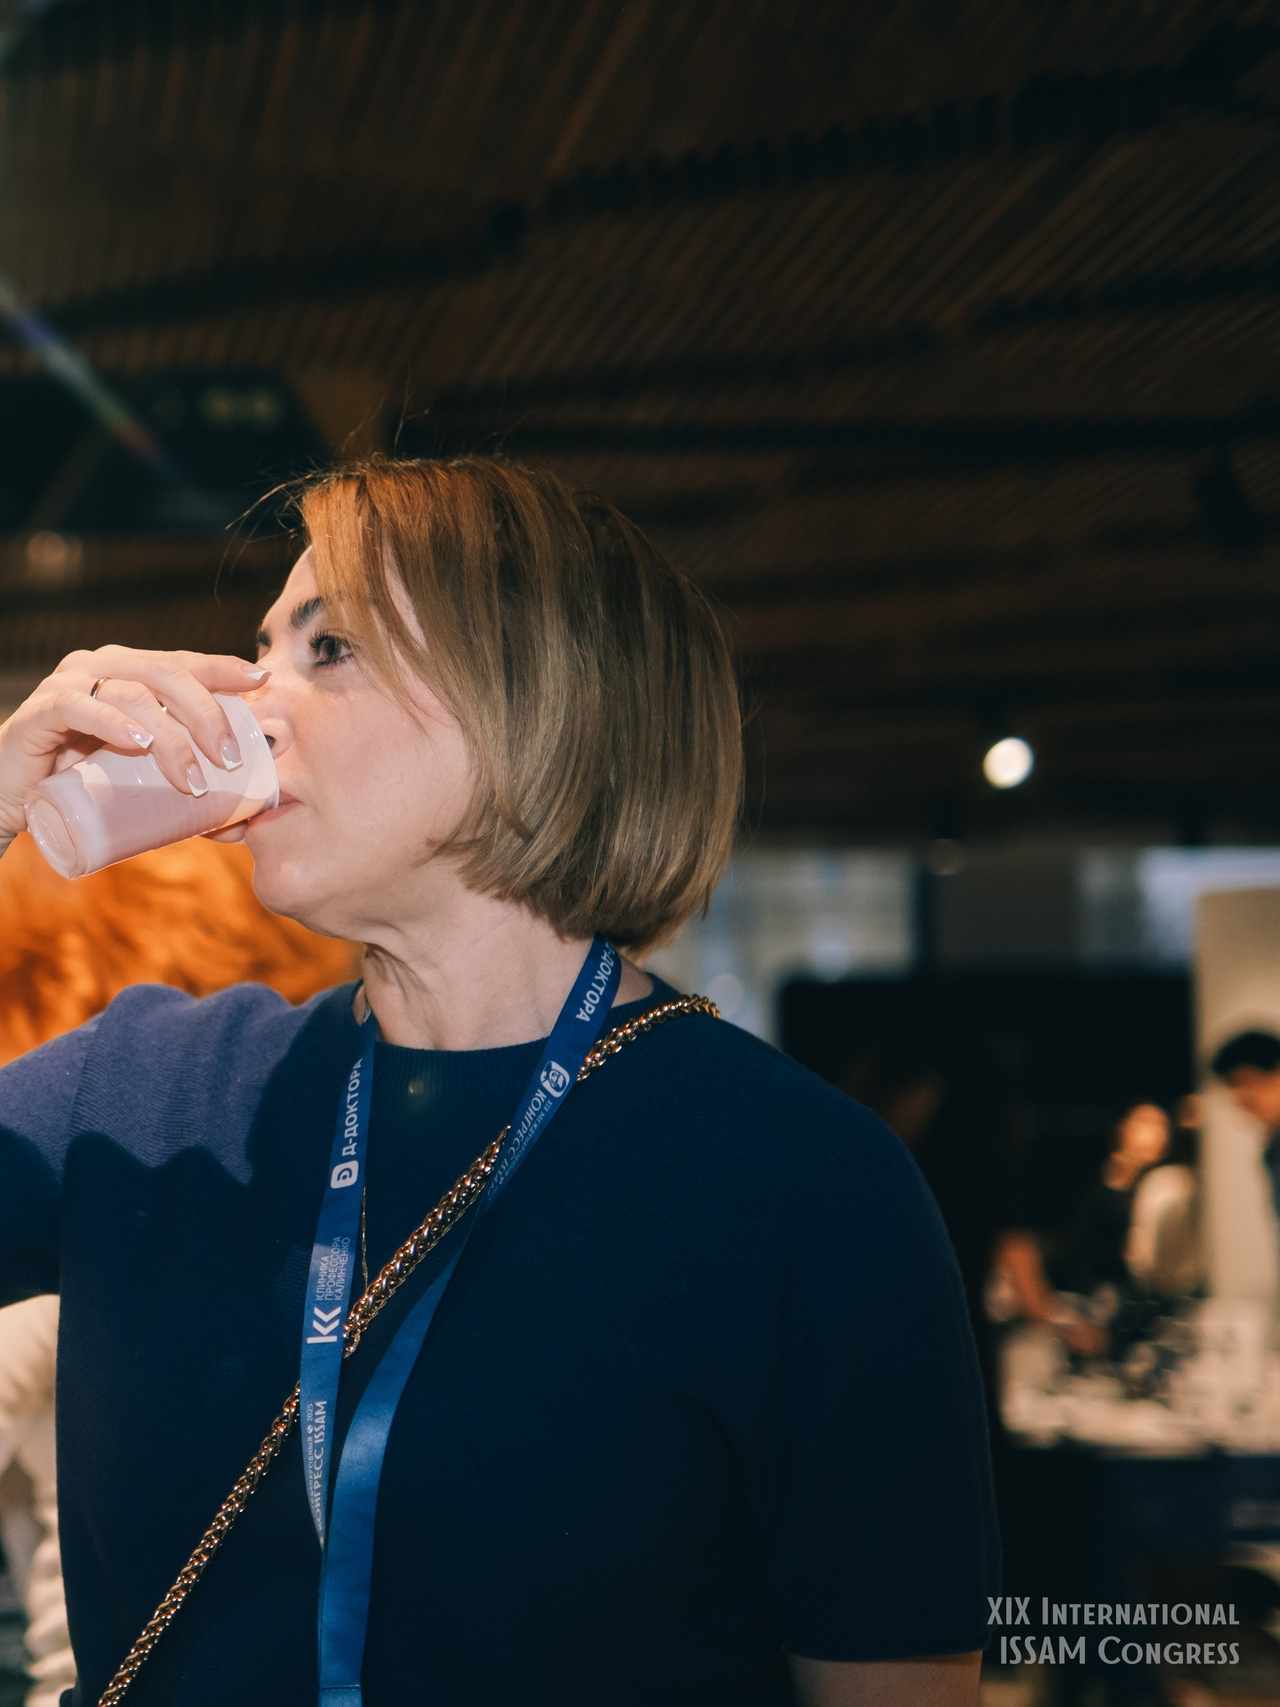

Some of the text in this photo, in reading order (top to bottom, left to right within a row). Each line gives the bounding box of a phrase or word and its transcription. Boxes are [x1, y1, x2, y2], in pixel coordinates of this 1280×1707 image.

[341, 1057, 363, 1157] Д-ДОКТОРА
[508, 1089, 547, 1160] КОНГРЕСС
[315, 1256, 331, 1301] КЛИНИКА
[325, 1236, 341, 1301] ПРОФЕССОРА
[334, 1237, 350, 1301] КАЛИНЧЕНКО
[314, 1401, 327, 1443] ISSAM
